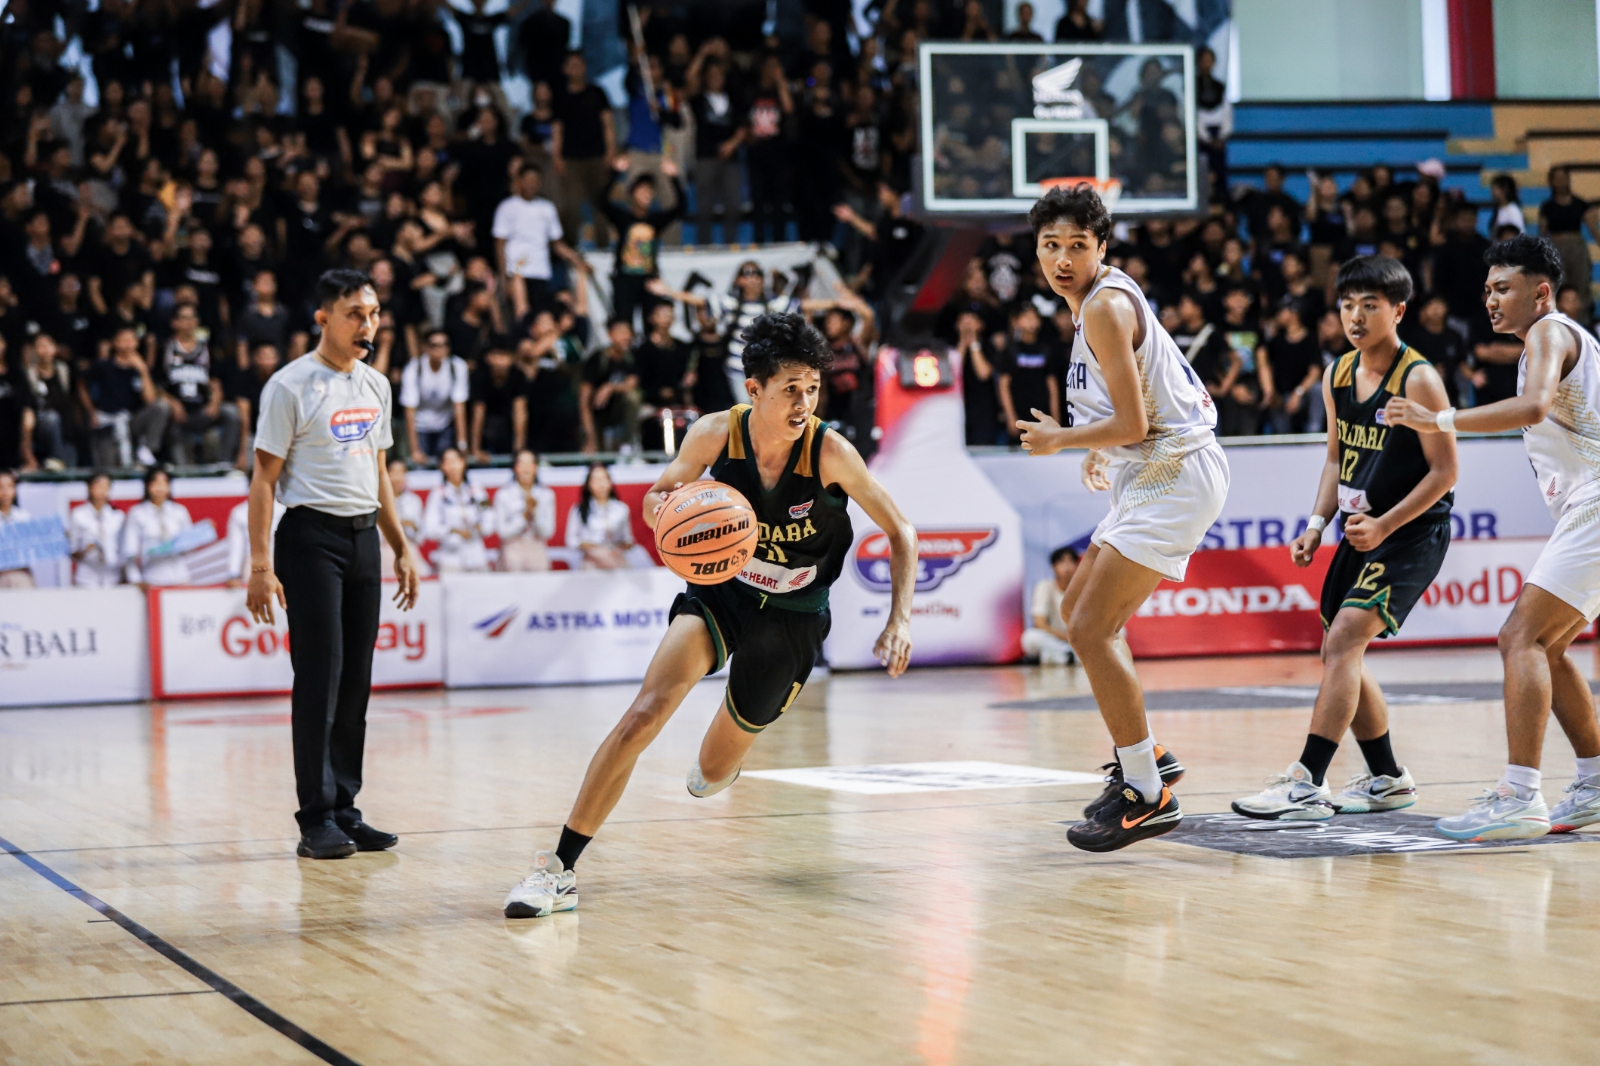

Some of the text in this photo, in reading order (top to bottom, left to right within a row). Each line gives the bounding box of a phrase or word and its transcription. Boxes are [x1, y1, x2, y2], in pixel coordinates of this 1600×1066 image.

[1340, 448, 1360, 483] 12
[677, 516, 750, 549] proteam
[757, 517, 817, 543] DARA
[1197, 518, 1310, 550] STRA
[690, 557, 731, 576] DBL
[748, 571, 779, 590] HEART.
[1352, 561, 1386, 591] 12
[1137, 583, 1318, 618] HONDA
[1421, 566, 1525, 607] oodD
[528, 607, 664, 631] ASTRA MOT
[22, 625, 98, 660] BALI
